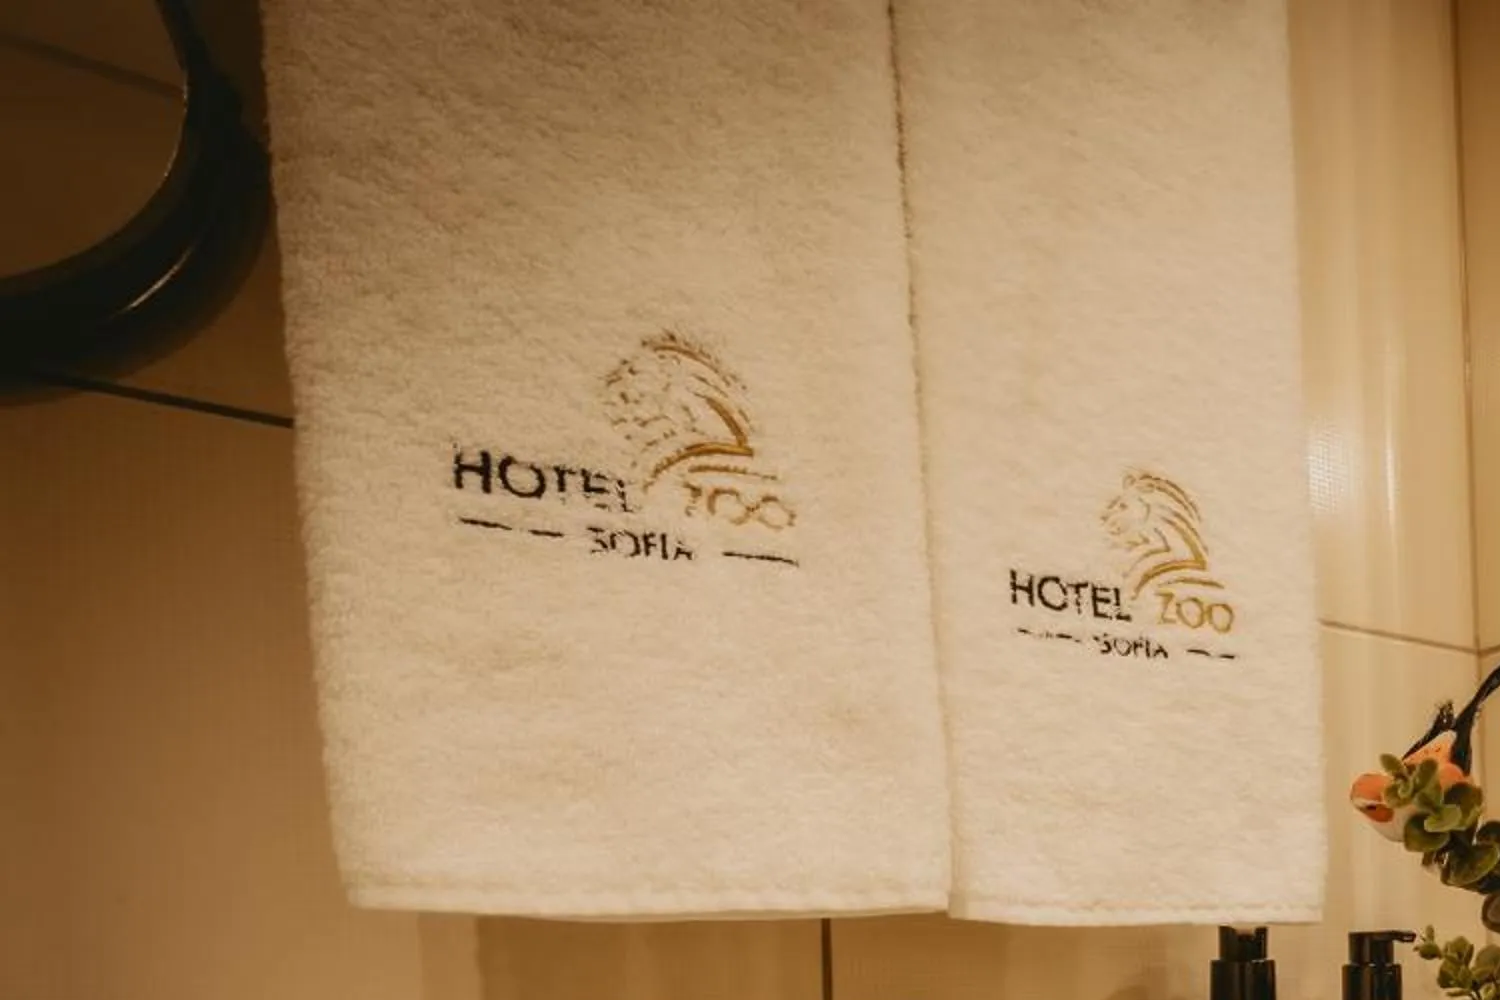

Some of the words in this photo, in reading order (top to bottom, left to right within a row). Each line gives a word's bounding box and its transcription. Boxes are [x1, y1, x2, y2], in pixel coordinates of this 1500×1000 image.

[452, 448, 640, 513] HOTEL
[683, 480, 798, 531] ZOO
[587, 524, 695, 562] SOFIA
[1009, 568, 1132, 623] HOTEL
[1155, 592, 1236, 634] ZOO
[1096, 633, 1169, 660] SOFIA
